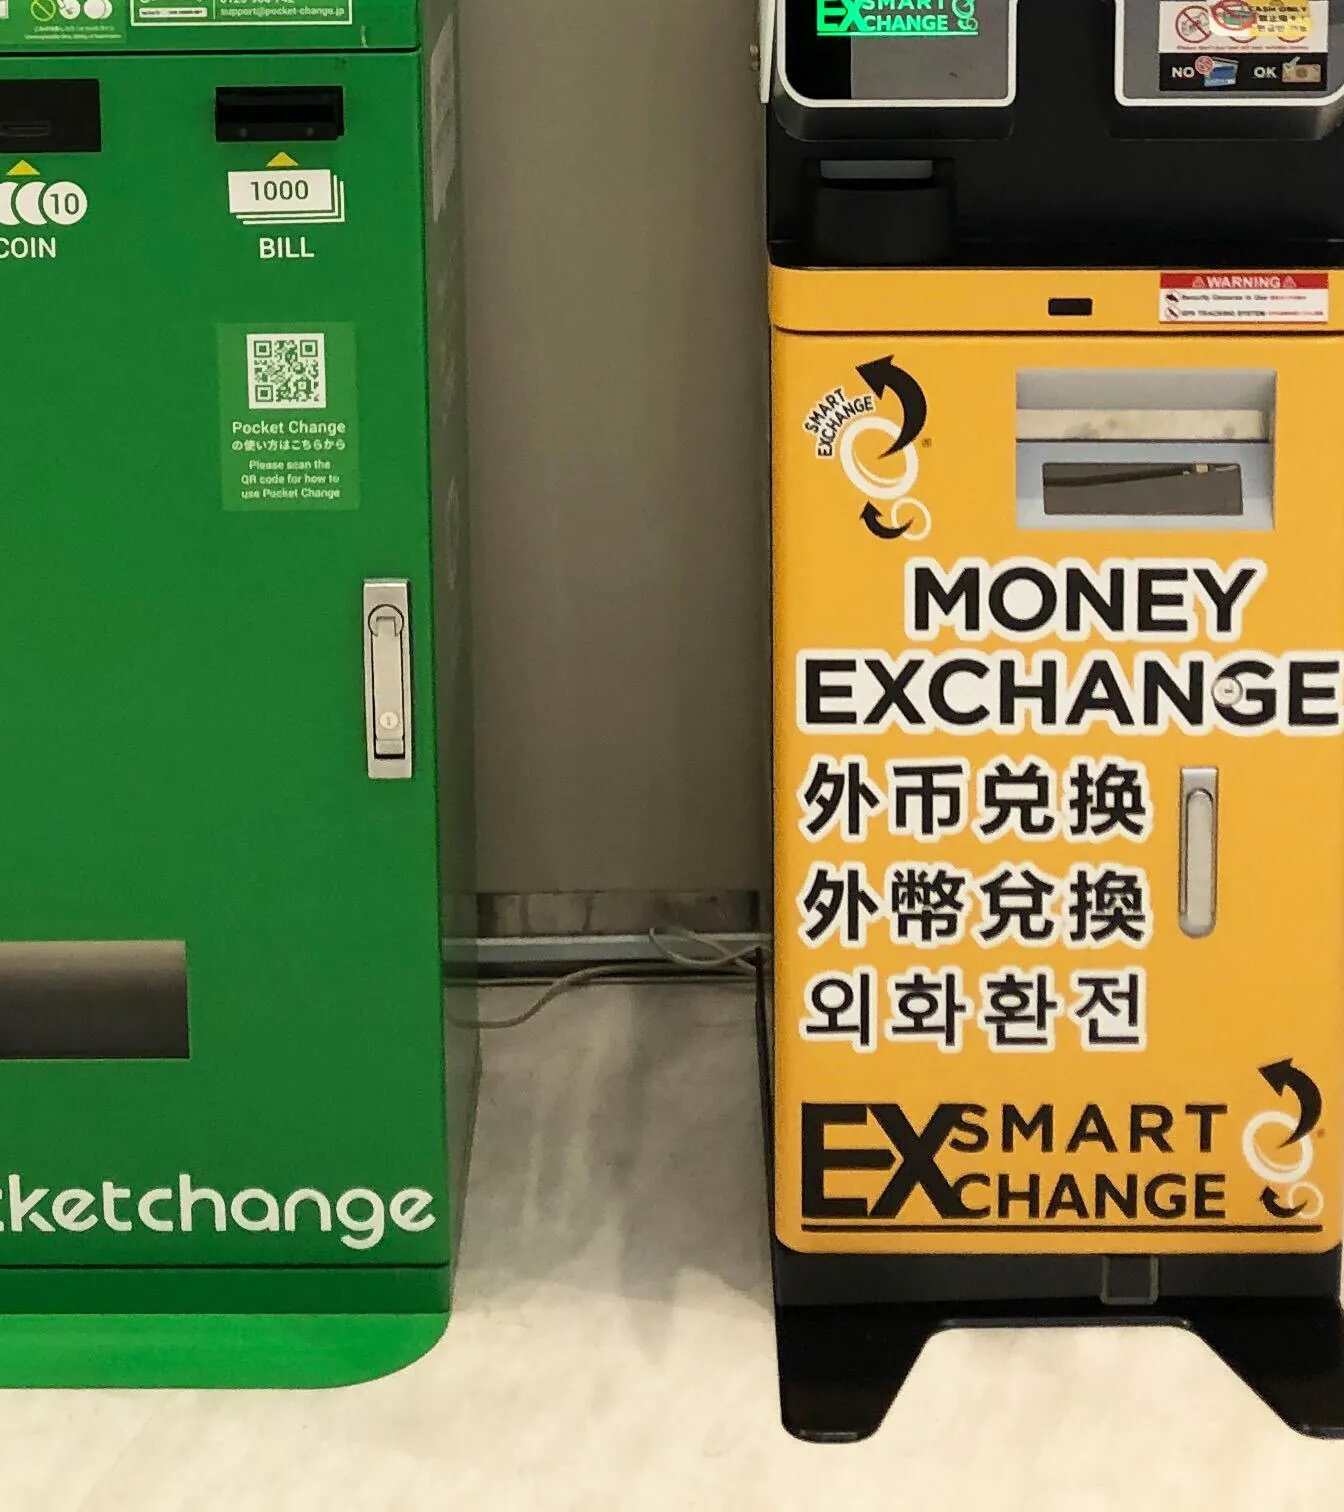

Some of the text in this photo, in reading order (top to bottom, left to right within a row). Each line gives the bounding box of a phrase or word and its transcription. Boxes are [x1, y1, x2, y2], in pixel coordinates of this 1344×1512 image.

[1172, 66, 1195, 78] NO
[1254, 66, 1277, 78] OK
[250, 180, 309, 201] 1000
[49, 192, 80, 216] 10
[259, 237, 315, 258] BILL
[1207, 275, 1281, 288] WARNING
[805, 388, 845, 433] SMART
[232, 420, 346, 436] Pocket Change
[818, 396, 874, 456] EXCHANGE
[232, 439, 346, 451] の使い方はこちらから
[249, 459, 331, 470] Please scan the
[241, 474, 339, 484] QR code for how to
[242, 488, 340, 499] use Pocket Change
[913, 566, 1258, 633] MONEY
[804, 658, 1340, 727] EXCHANGE
[803, 761, 1148, 836] 外币兑换
[805, 973, 1143, 1047] 외화환전
[949, 1103, 1228, 1153] SMART
